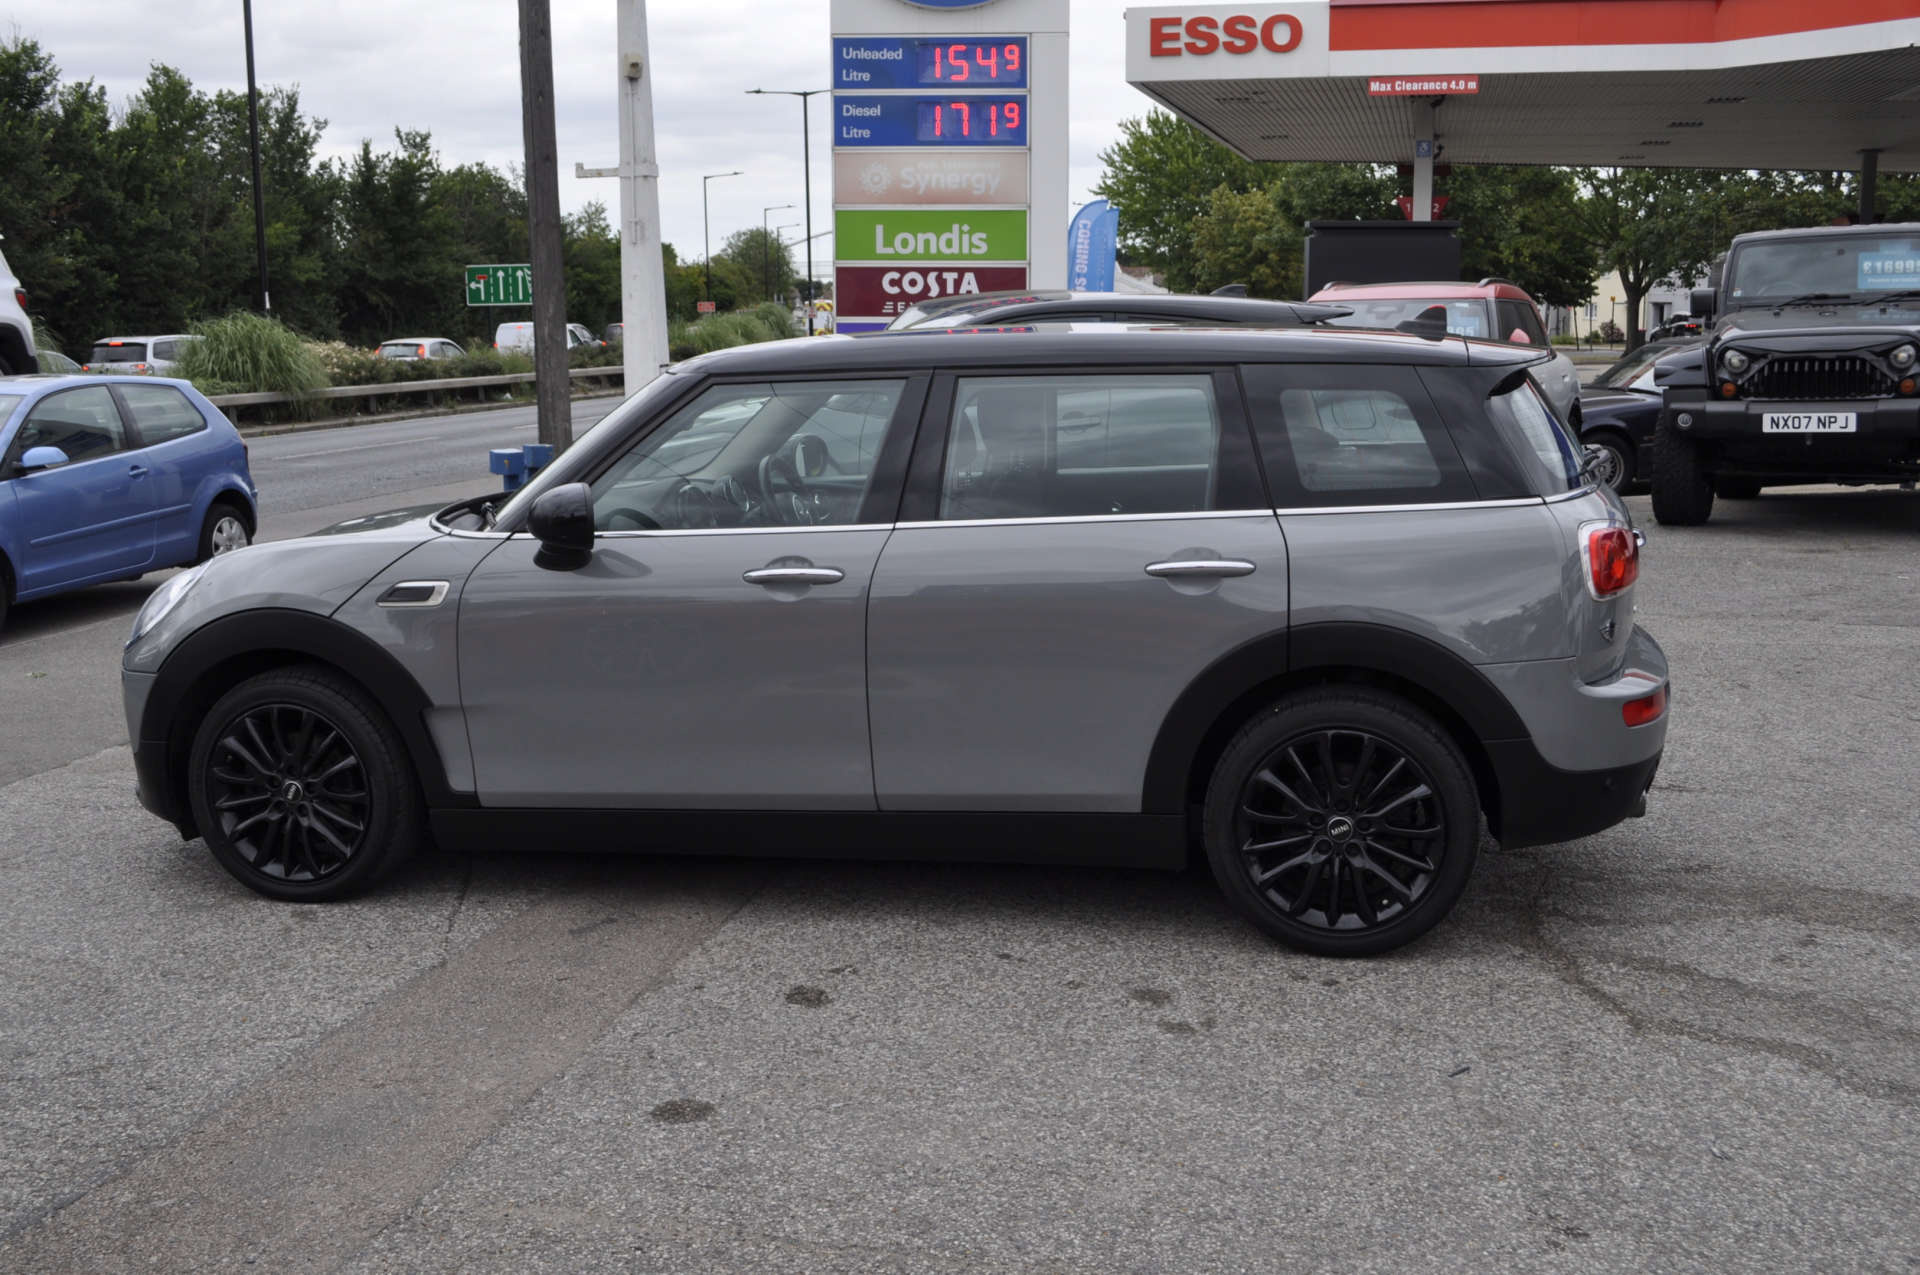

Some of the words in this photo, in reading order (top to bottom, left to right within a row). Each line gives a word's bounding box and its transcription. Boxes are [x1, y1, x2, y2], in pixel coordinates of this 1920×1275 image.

[1150, 14, 1303, 57] ESSO
[842, 47, 903, 60] Unleaded
[842, 69, 871, 81] Litre
[1370, 80, 1392, 92] Max
[1394, 79, 1448, 91] Clearance
[1449, 79, 1466, 91] 4.0
[1467, 81, 1477, 90] m
[842, 104, 881, 117] Diesel
[842, 126, 871, 138] Litre
[900, 167, 1001, 195] Synergy
[875, 223, 988, 254] Londis
[881, 271, 980, 297] COSTA
[1769, 416, 1812, 430] NX07
[1817, 416, 1849, 430] NPJ
